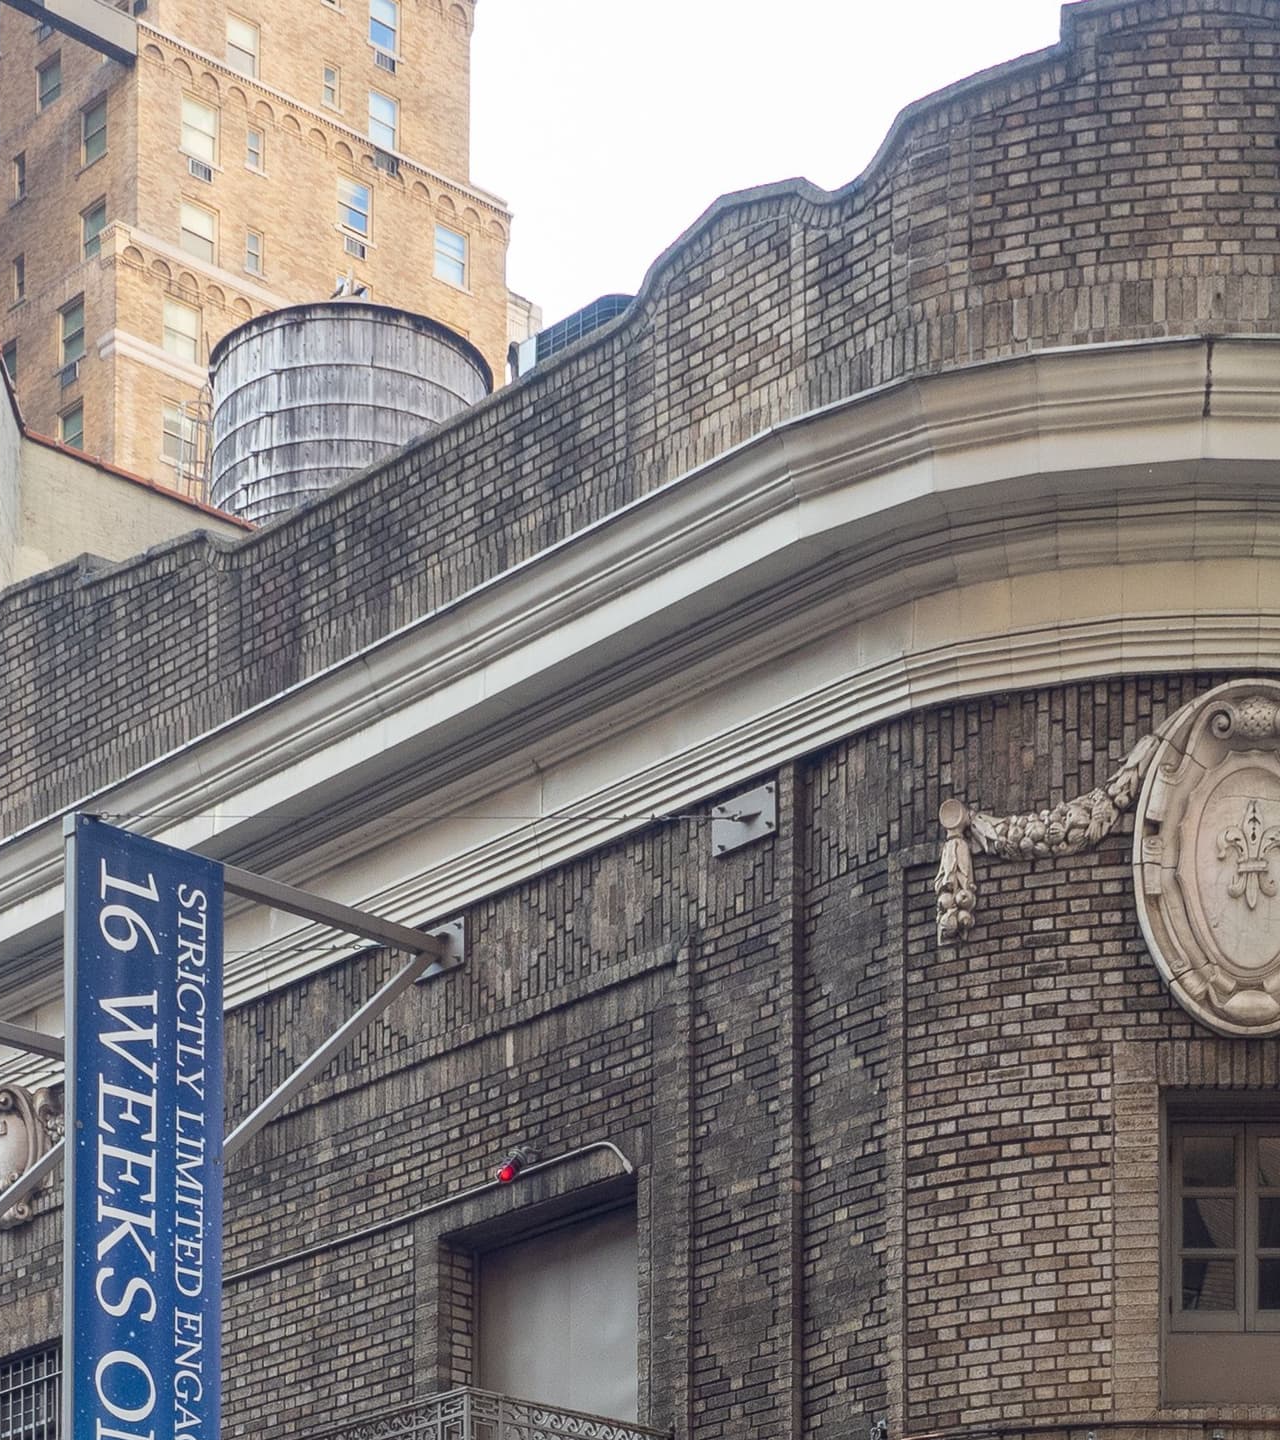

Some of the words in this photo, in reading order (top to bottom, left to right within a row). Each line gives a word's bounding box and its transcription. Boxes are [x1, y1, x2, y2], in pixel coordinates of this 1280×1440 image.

[99, 857, 160, 956] 16
[177, 884, 207, 1101] STRICTLY
[96, 988, 160, 1325] WEEKS
[175, 1108, 207, 1298] LIMITED
